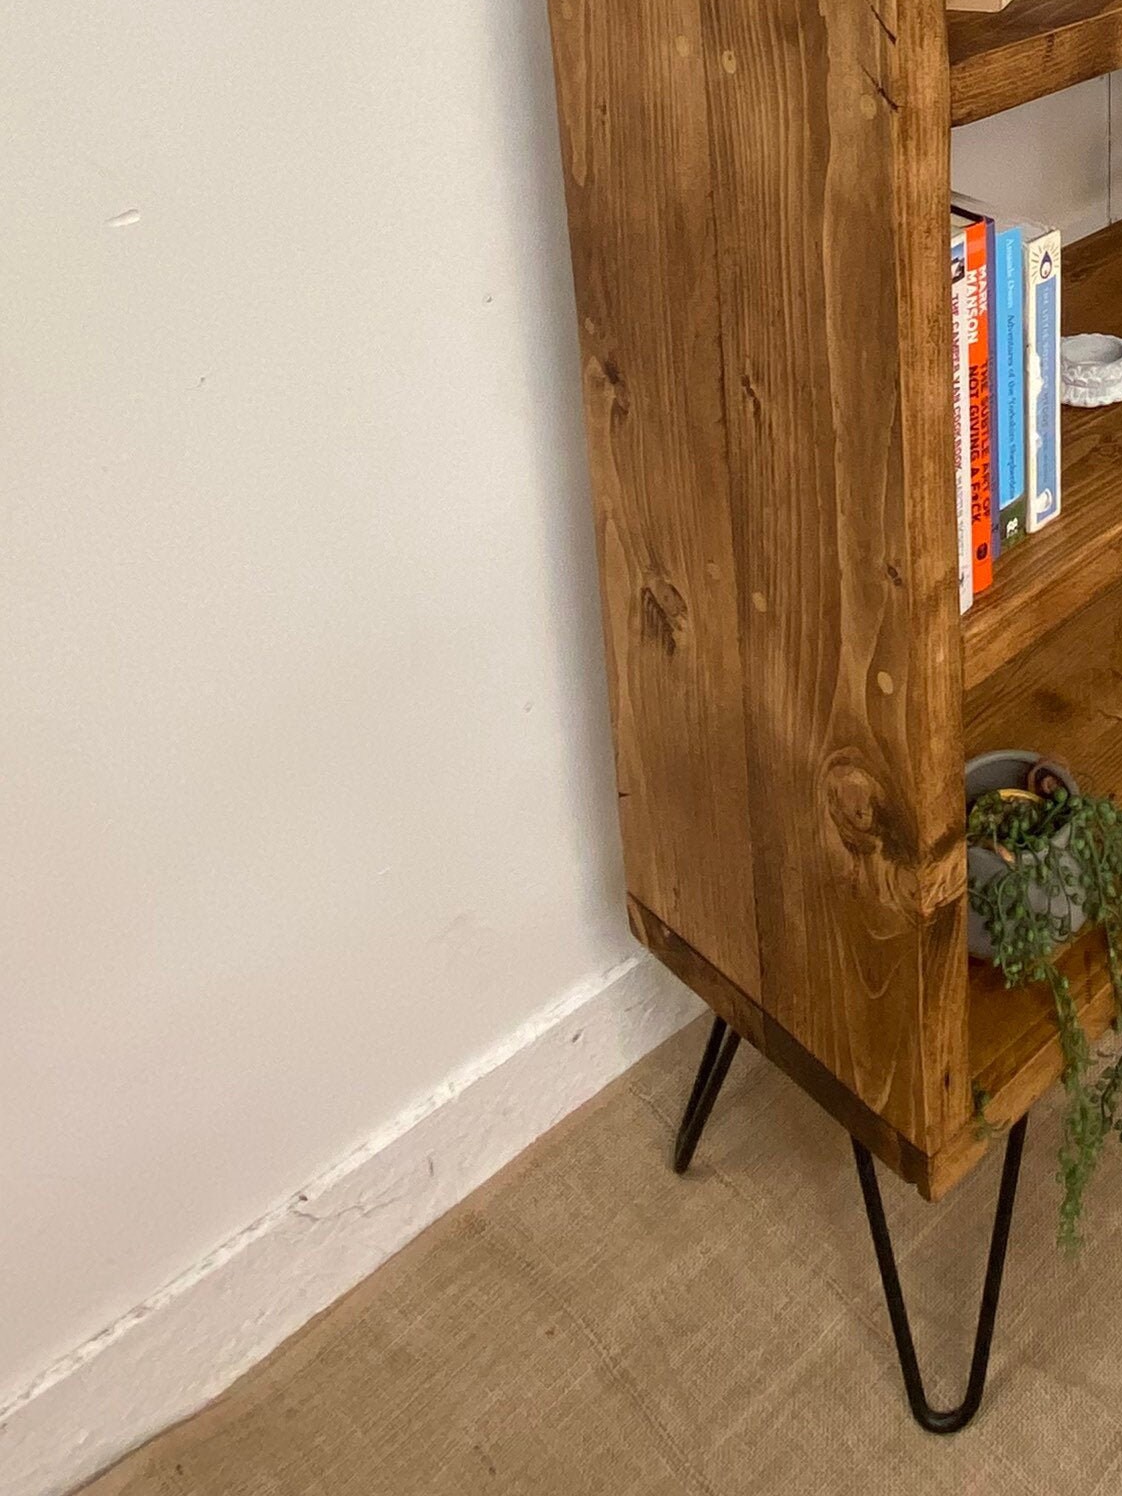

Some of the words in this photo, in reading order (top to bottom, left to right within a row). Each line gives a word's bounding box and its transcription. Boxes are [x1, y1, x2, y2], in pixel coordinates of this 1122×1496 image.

[967, 270, 979, 344] MANSON
[978, 265, 988, 316] MARK
[969, 364, 979, 398] NOT
[980, 361, 989, 393] THE
[970, 405, 980, 464] GIVING
[981, 395, 990, 459] SUBTLE
[971, 467, 980, 477] A
[982, 462, 991, 492] ART
[982, 497, 991, 517] OF
